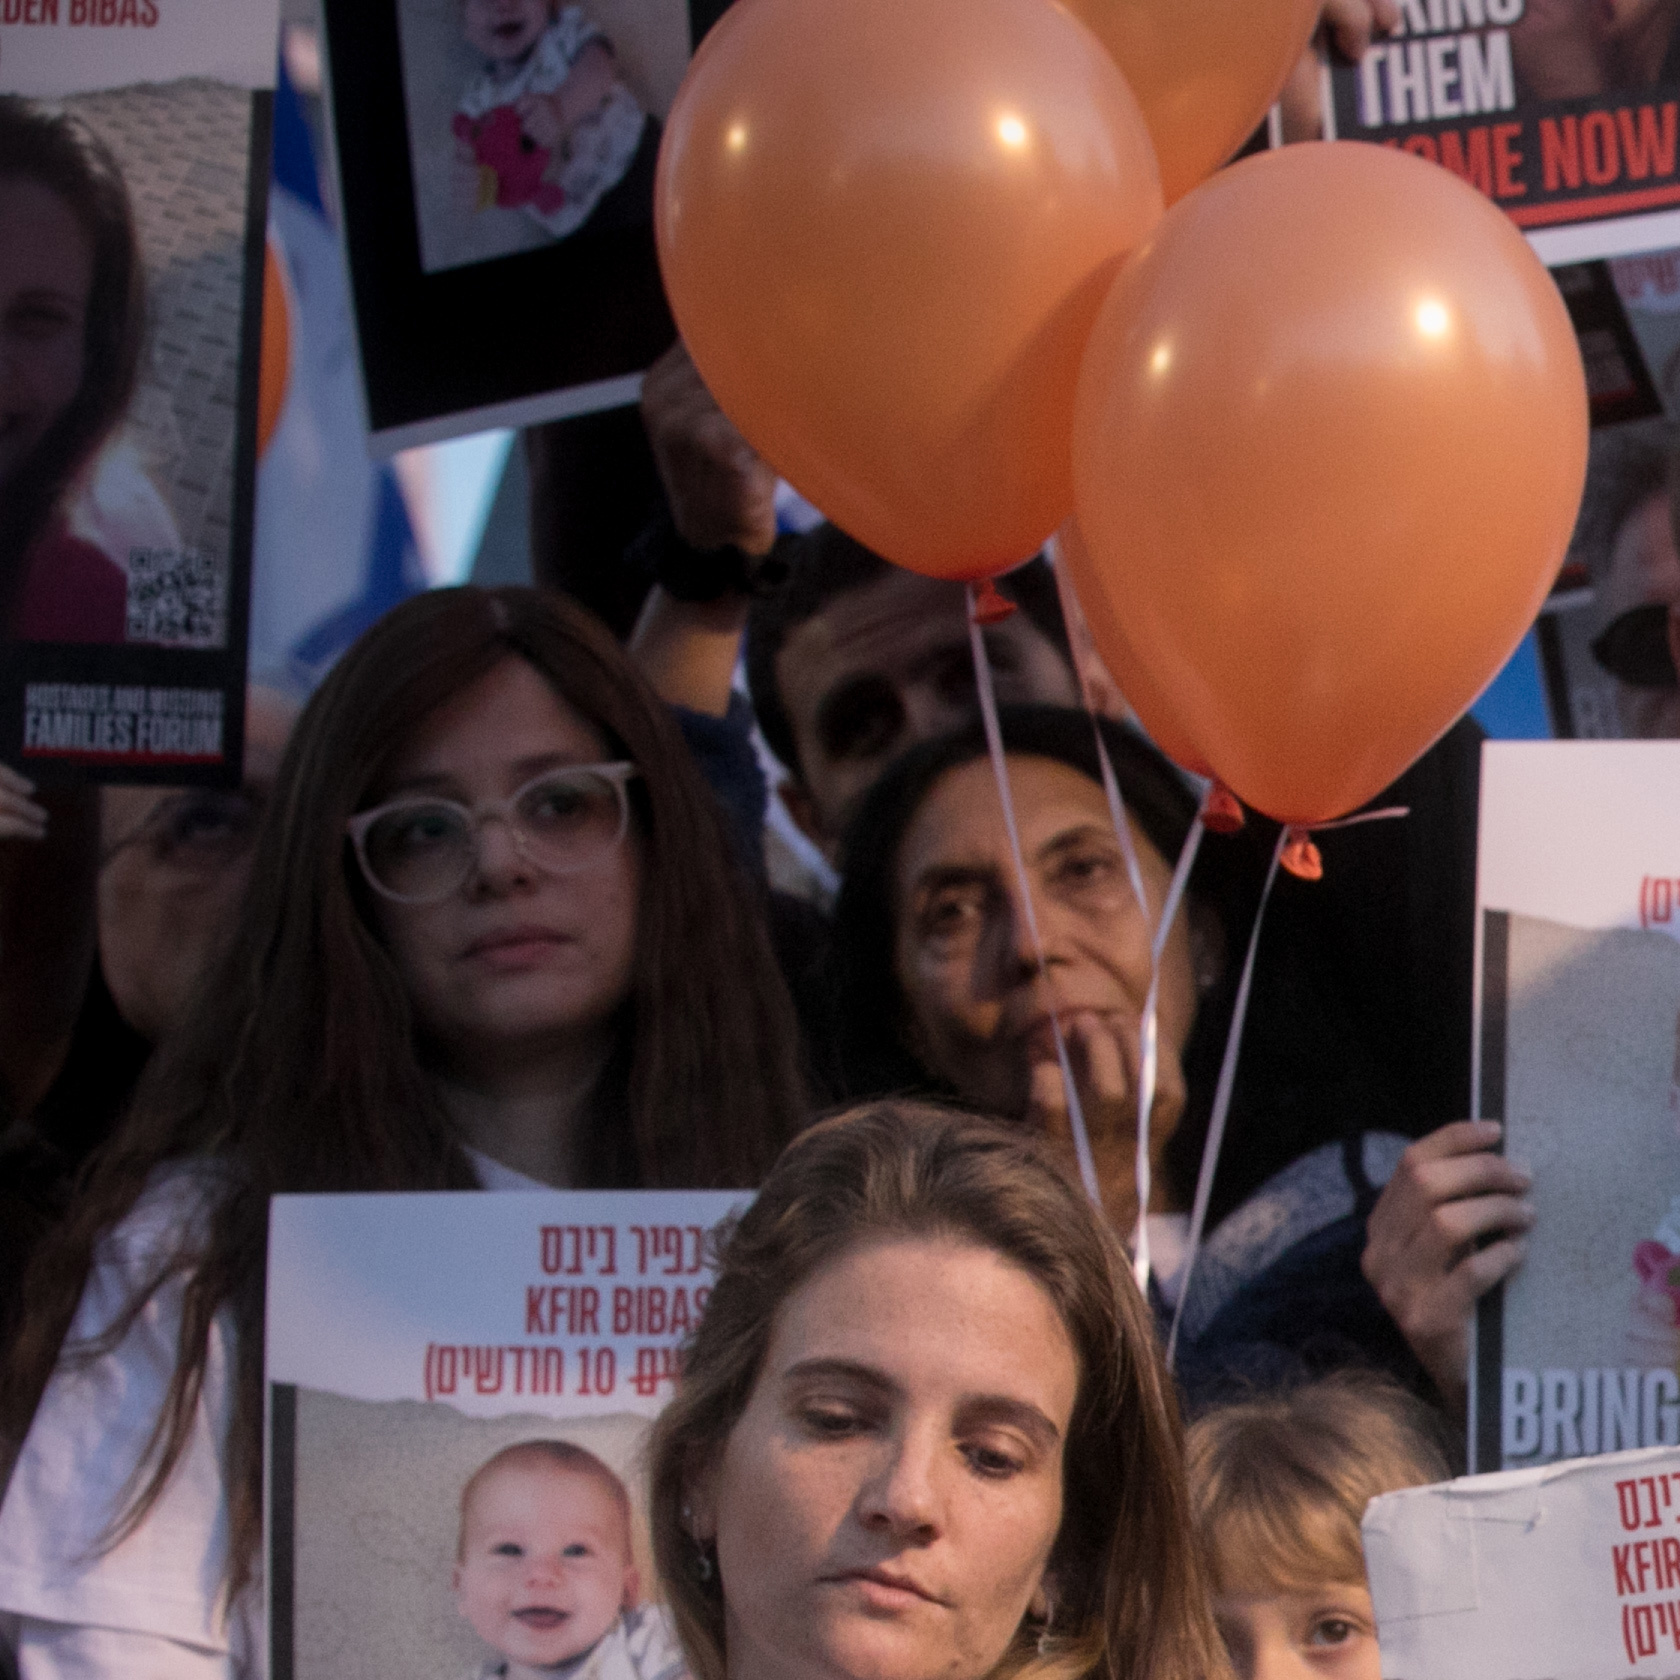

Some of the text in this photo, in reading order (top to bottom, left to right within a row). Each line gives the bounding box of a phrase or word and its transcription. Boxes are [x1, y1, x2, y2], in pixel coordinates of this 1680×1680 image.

[1357, 28, 1516, 128] THEM
[1380, 122, 1527, 200] ME
[540, 1225, 702, 1276] כפיר ביבס
[524, 1285, 600, 1336] KFIR
[577, 1346, 617, 1397] 10
